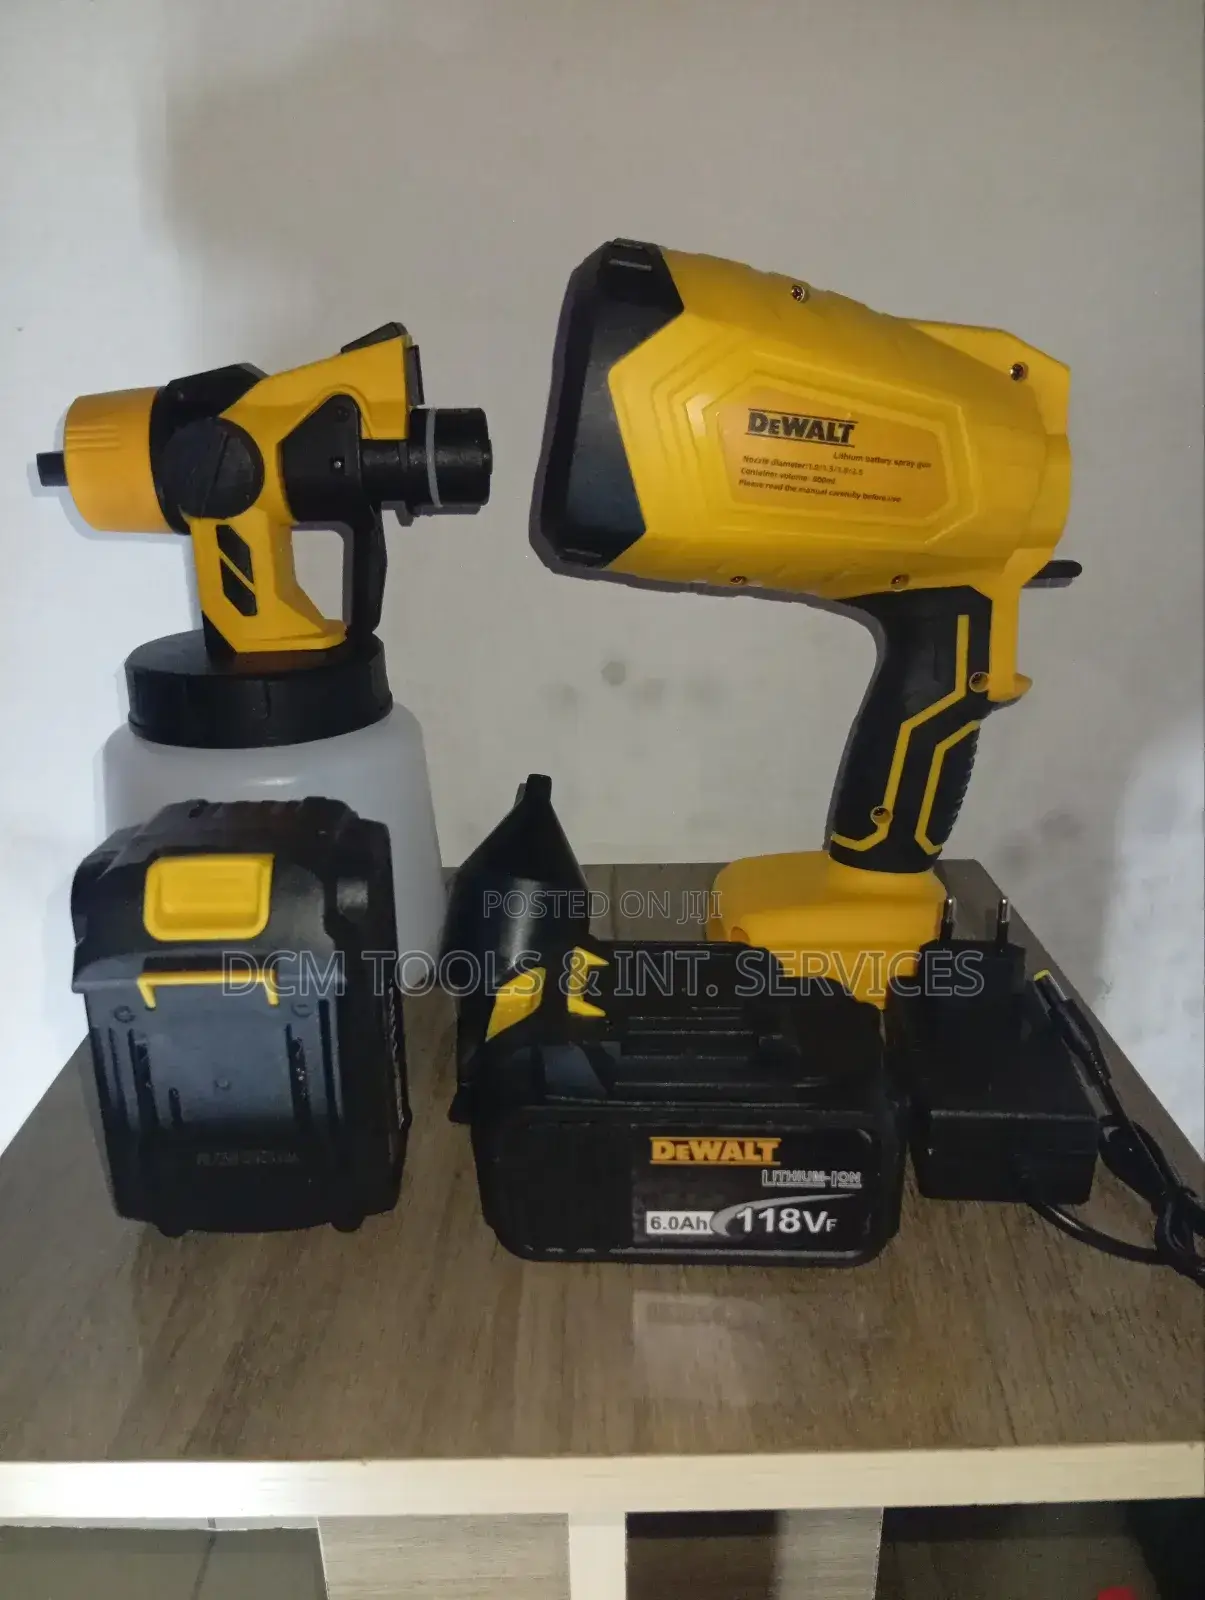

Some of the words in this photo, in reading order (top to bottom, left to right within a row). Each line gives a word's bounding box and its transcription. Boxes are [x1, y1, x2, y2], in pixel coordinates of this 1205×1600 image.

[742, 454, 770, 465] Nozzle
[833, 451, 863, 462] Lithium
[864, 455, 892, 466] battery
[893, 458, 915, 469] spray
[916, 461, 932, 470] gun
[740, 467, 778, 479] Container
[738, 479, 764, 489] Please
[765, 482, 784, 492] read
[784, 484, 797, 493] the
[798, 486, 828, 496] manual
[862, 491, 886, 501] before
[649, 1214, 709, 1231] 6.0Ah
